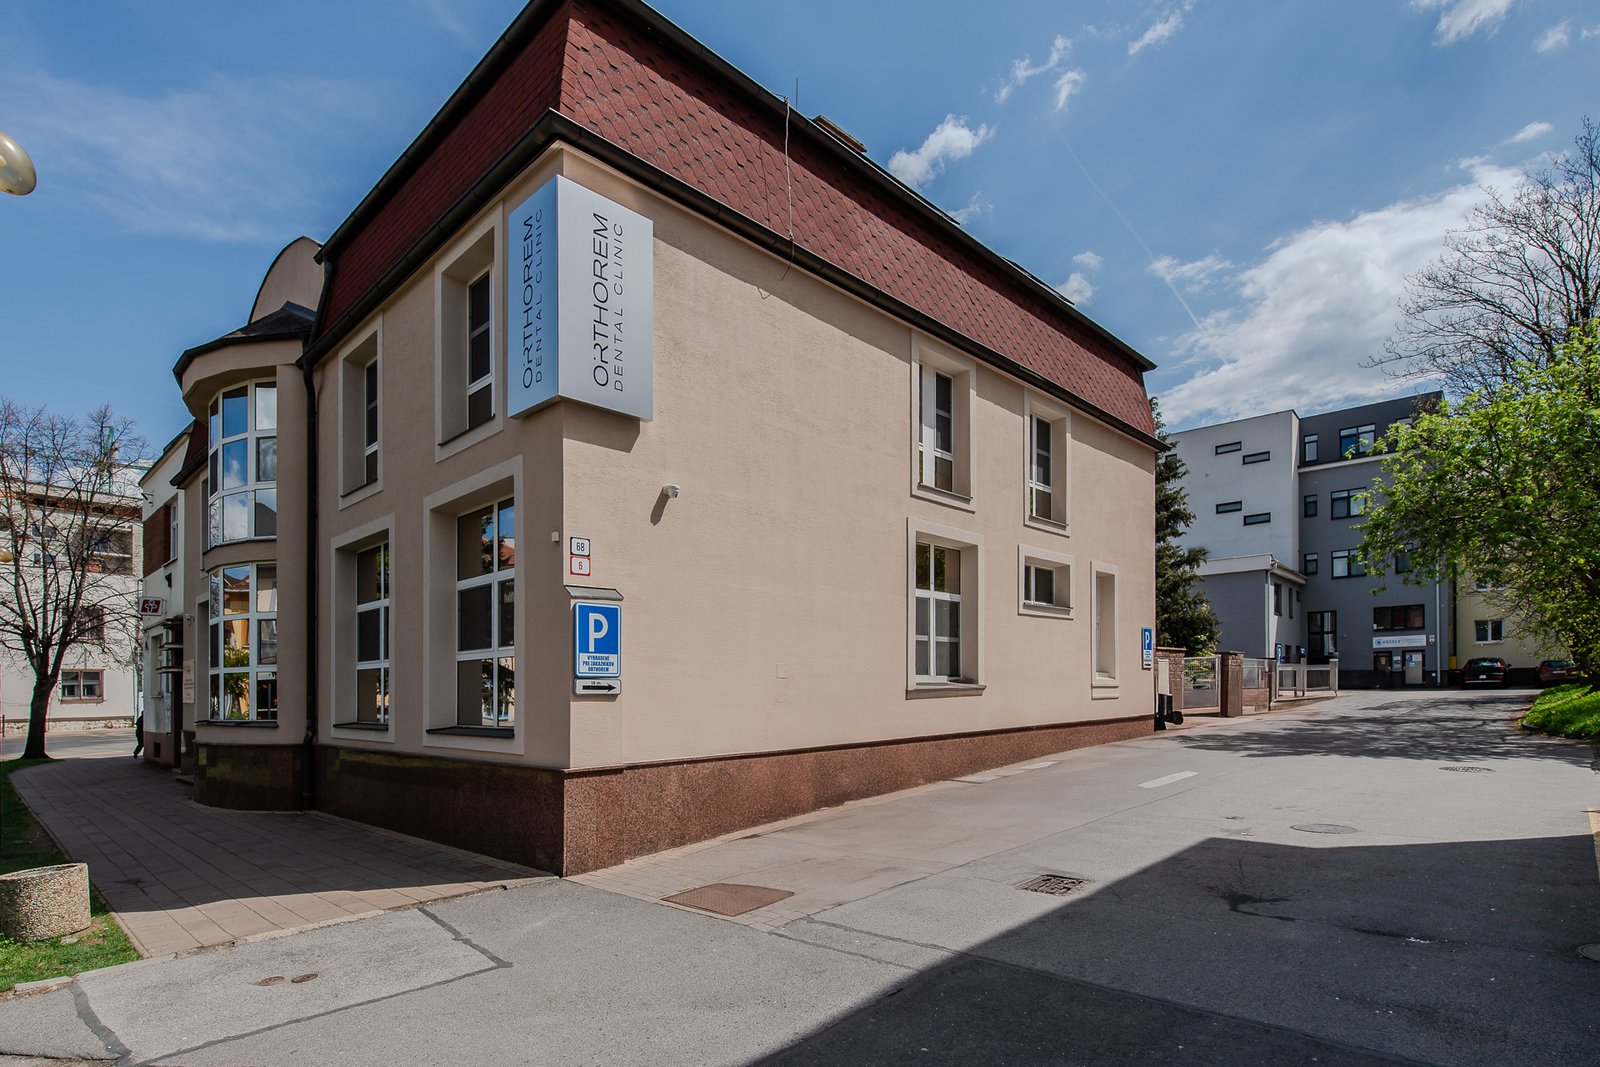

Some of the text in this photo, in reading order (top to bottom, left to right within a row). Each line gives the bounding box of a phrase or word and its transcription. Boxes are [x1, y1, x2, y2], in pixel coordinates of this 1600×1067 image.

[523, 215, 534, 388] ORTHOREM
[535, 208, 543, 383] DENTAL CLINIC
[593, 212, 609, 387] ORTHOREM
[613, 223, 624, 392] DENTAL CLINIC
[576, 542, 585, 552] 68
[578, 562, 583, 571] 6
[588, 613, 609, 653] P
[1145, 631, 1150, 650] P
